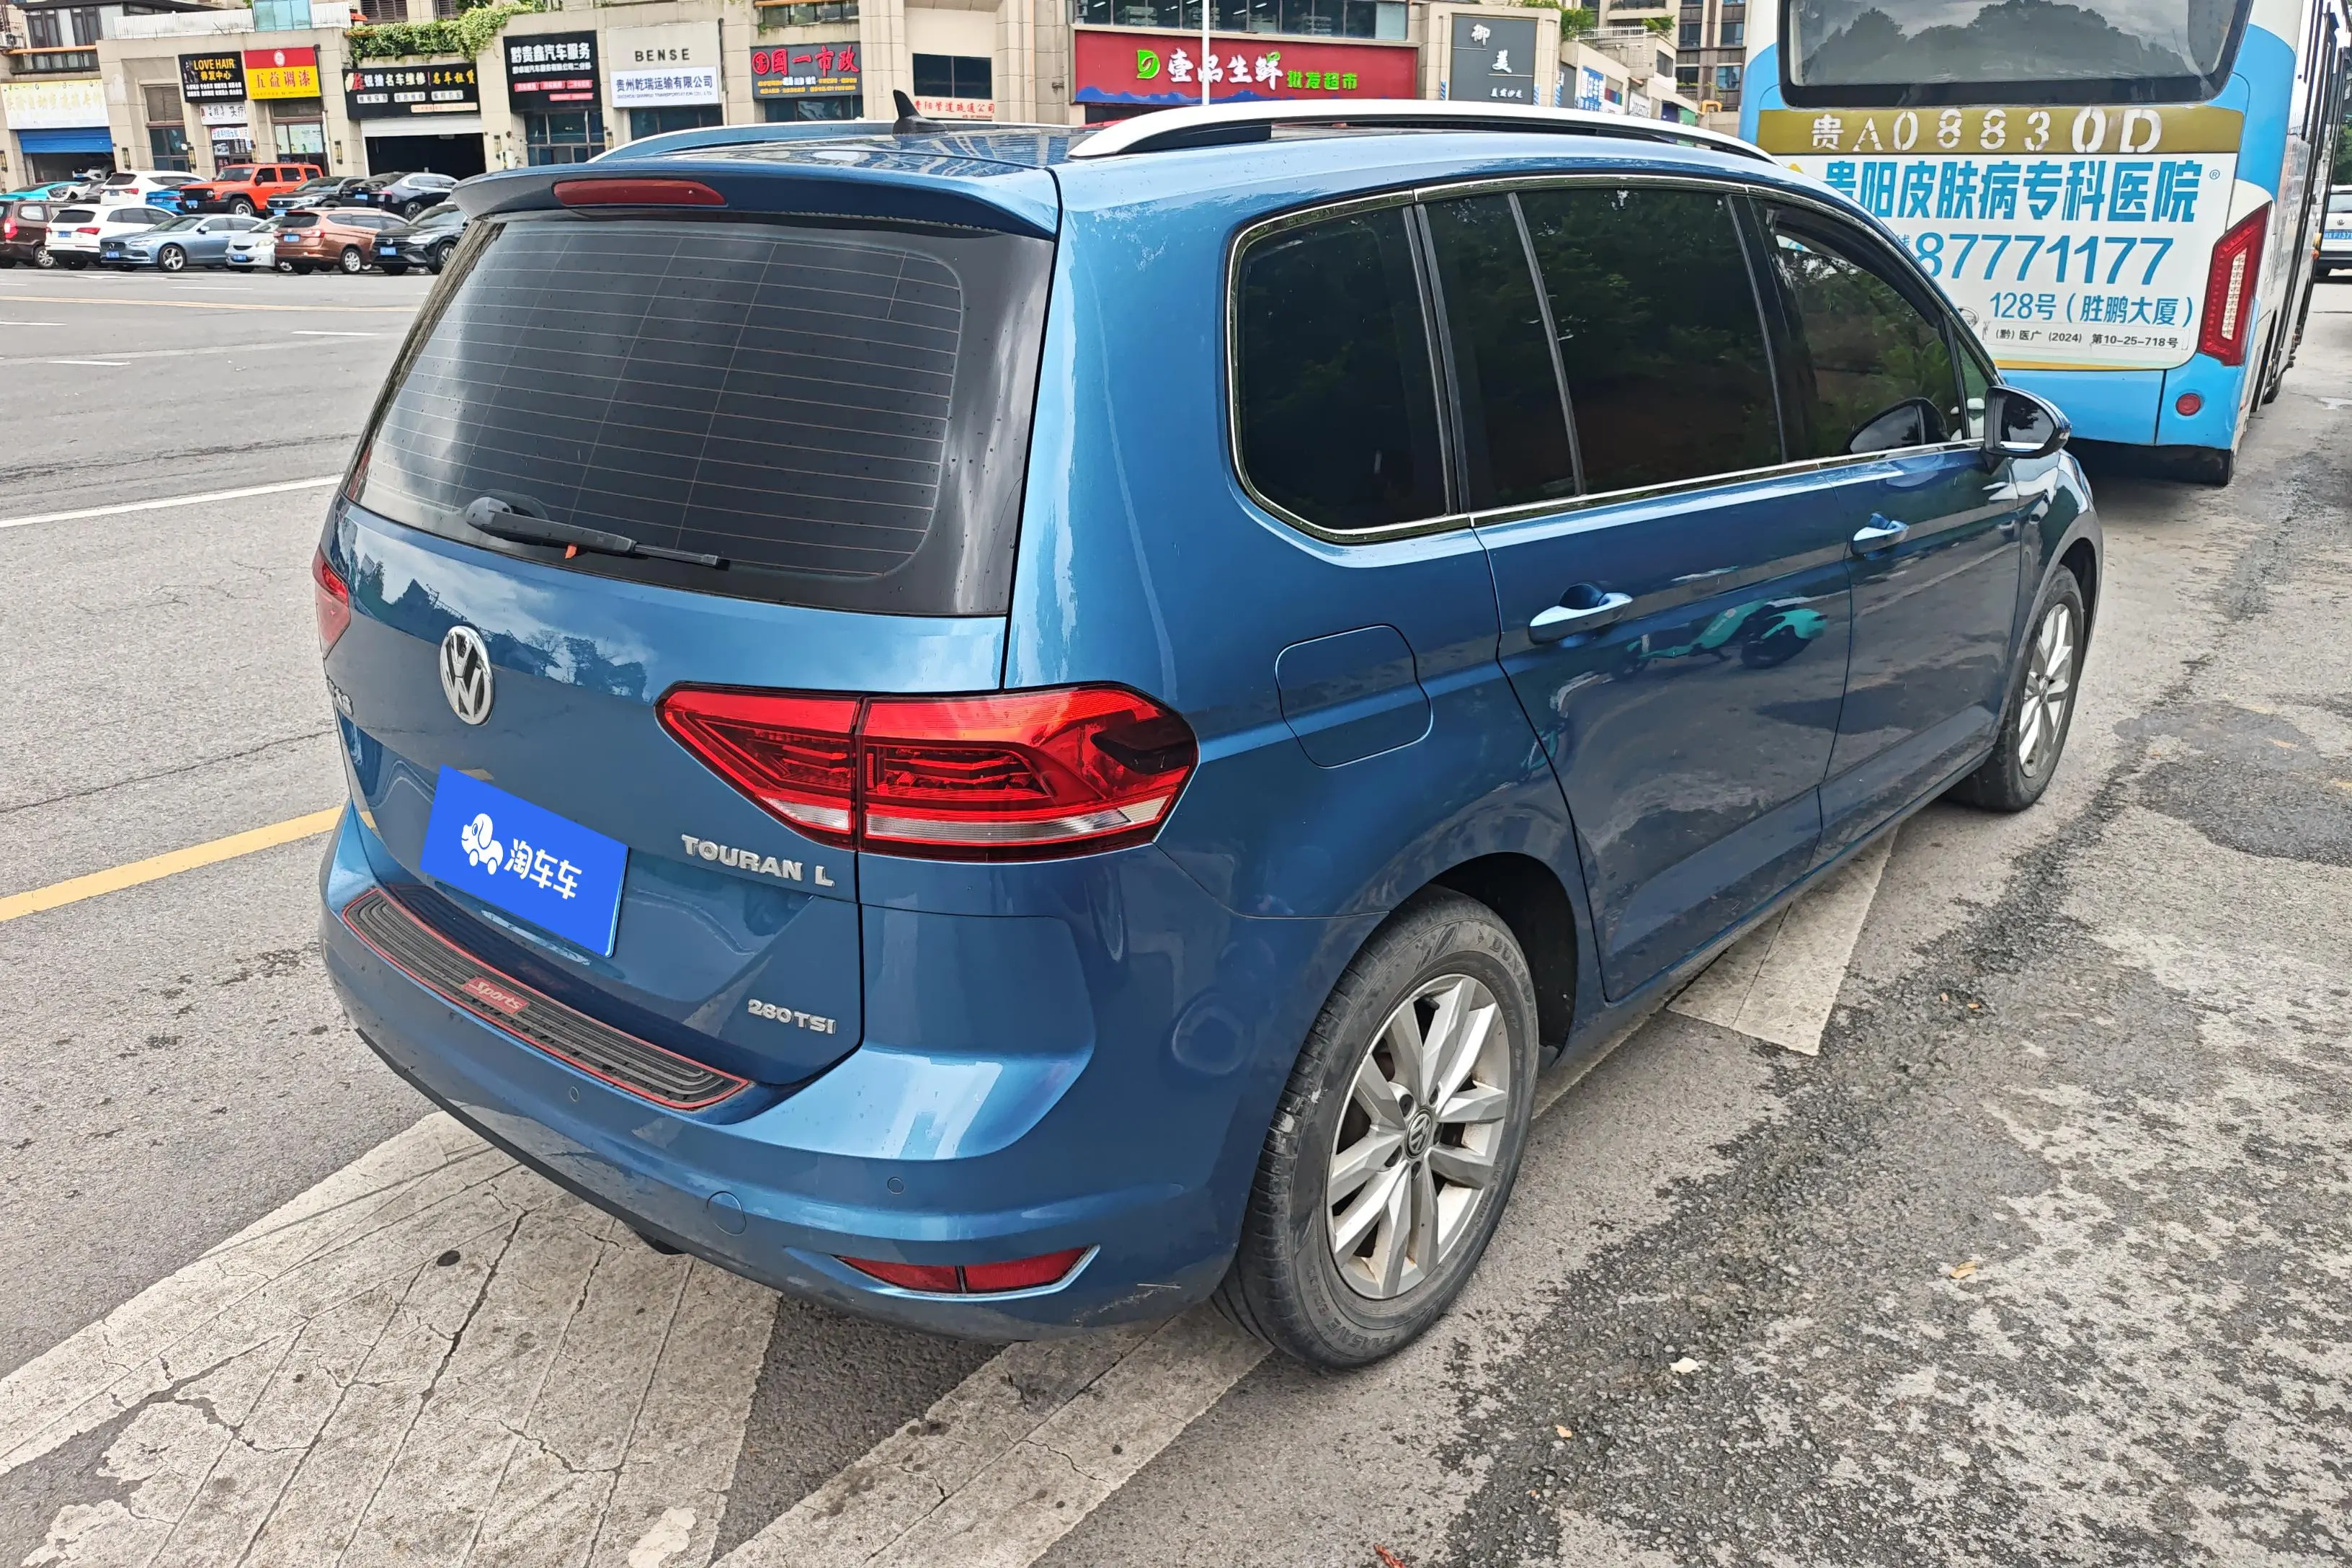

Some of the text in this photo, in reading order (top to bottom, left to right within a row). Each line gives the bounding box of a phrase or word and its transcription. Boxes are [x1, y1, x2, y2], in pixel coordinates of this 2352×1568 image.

[193, 58, 235, 70] LOVE HAIR
[635, 48, 690, 62] BENSE
[616, 75, 713, 92] 贵州乾瑞运输有限公司
[1286, 70, 1358, 90] 批发超市
[1824, 160, 2203, 223] 贵阳皮肤病专科医院
[1915, 231, 2174, 285] 87771177
[681, 834, 835, 887] TOURAN L
[468, 981, 523, 1010] Sports
